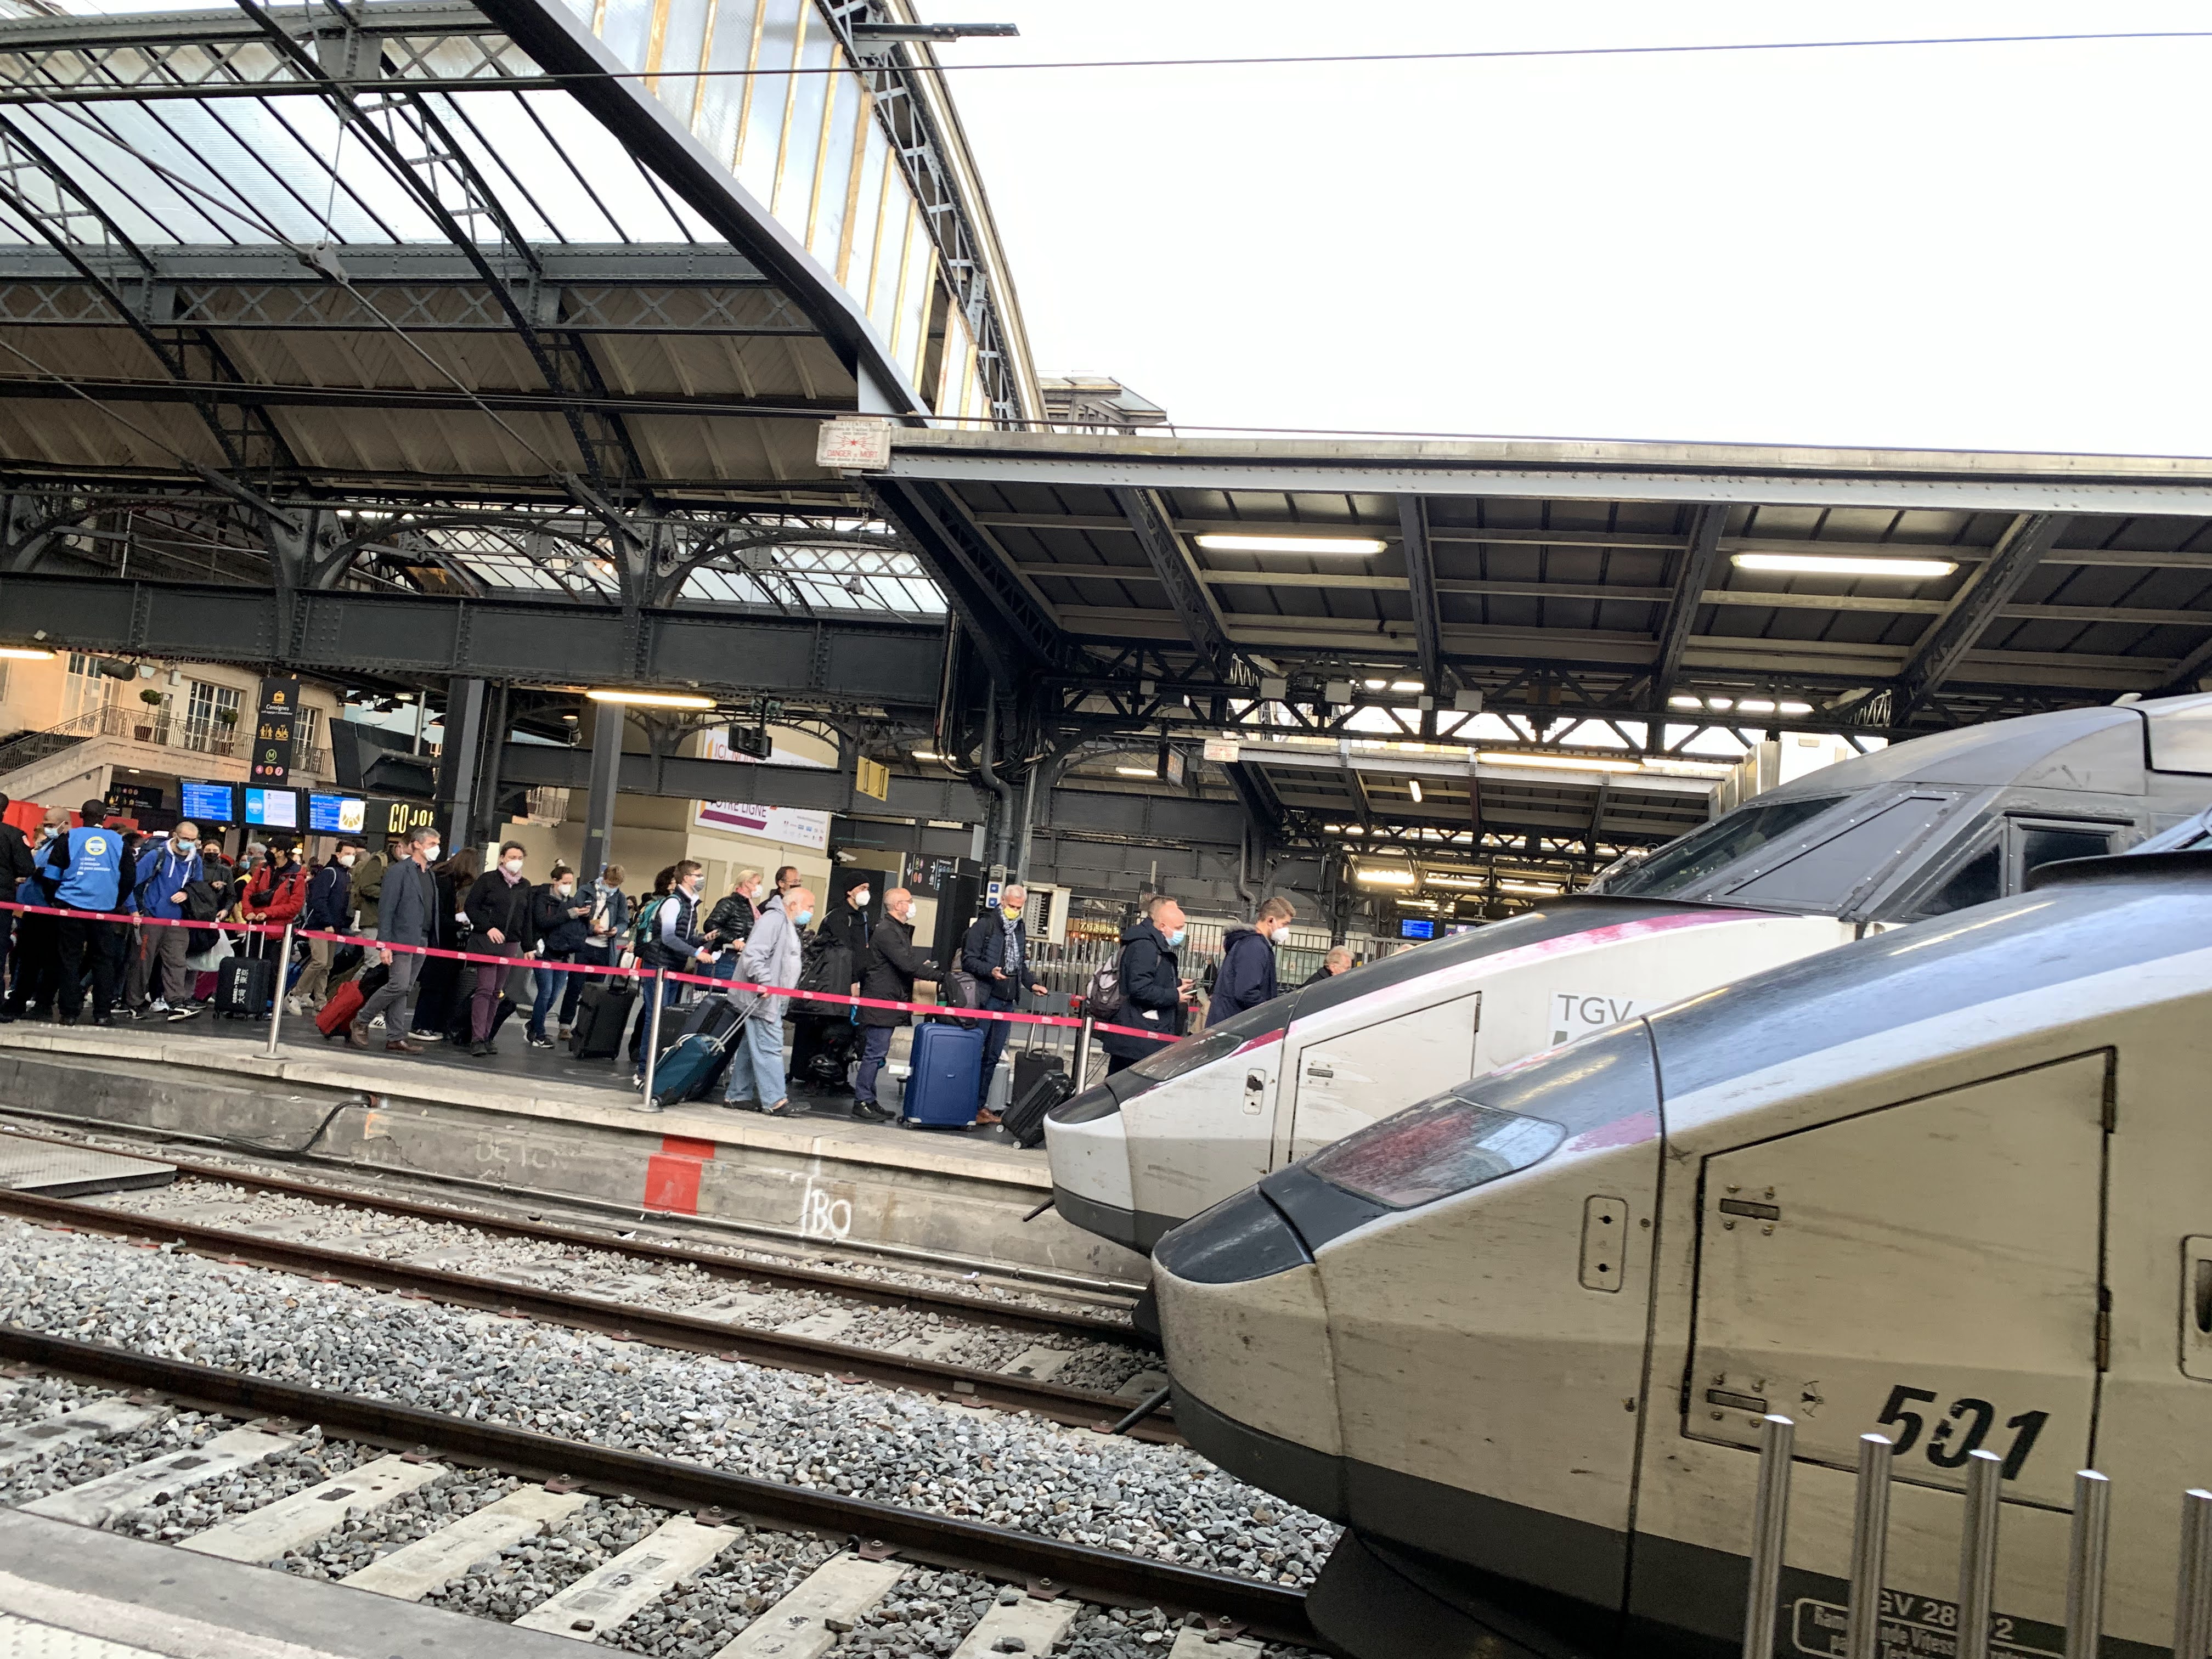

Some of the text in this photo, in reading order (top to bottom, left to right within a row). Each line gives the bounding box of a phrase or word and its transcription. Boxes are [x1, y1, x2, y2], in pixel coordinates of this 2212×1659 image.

[266, 704, 290, 712] Consignes
[1558, 994, 1634, 1025] TGV
[1876, 1384, 2051, 1481] 501
[1880, 1590, 1914, 1617] GV
